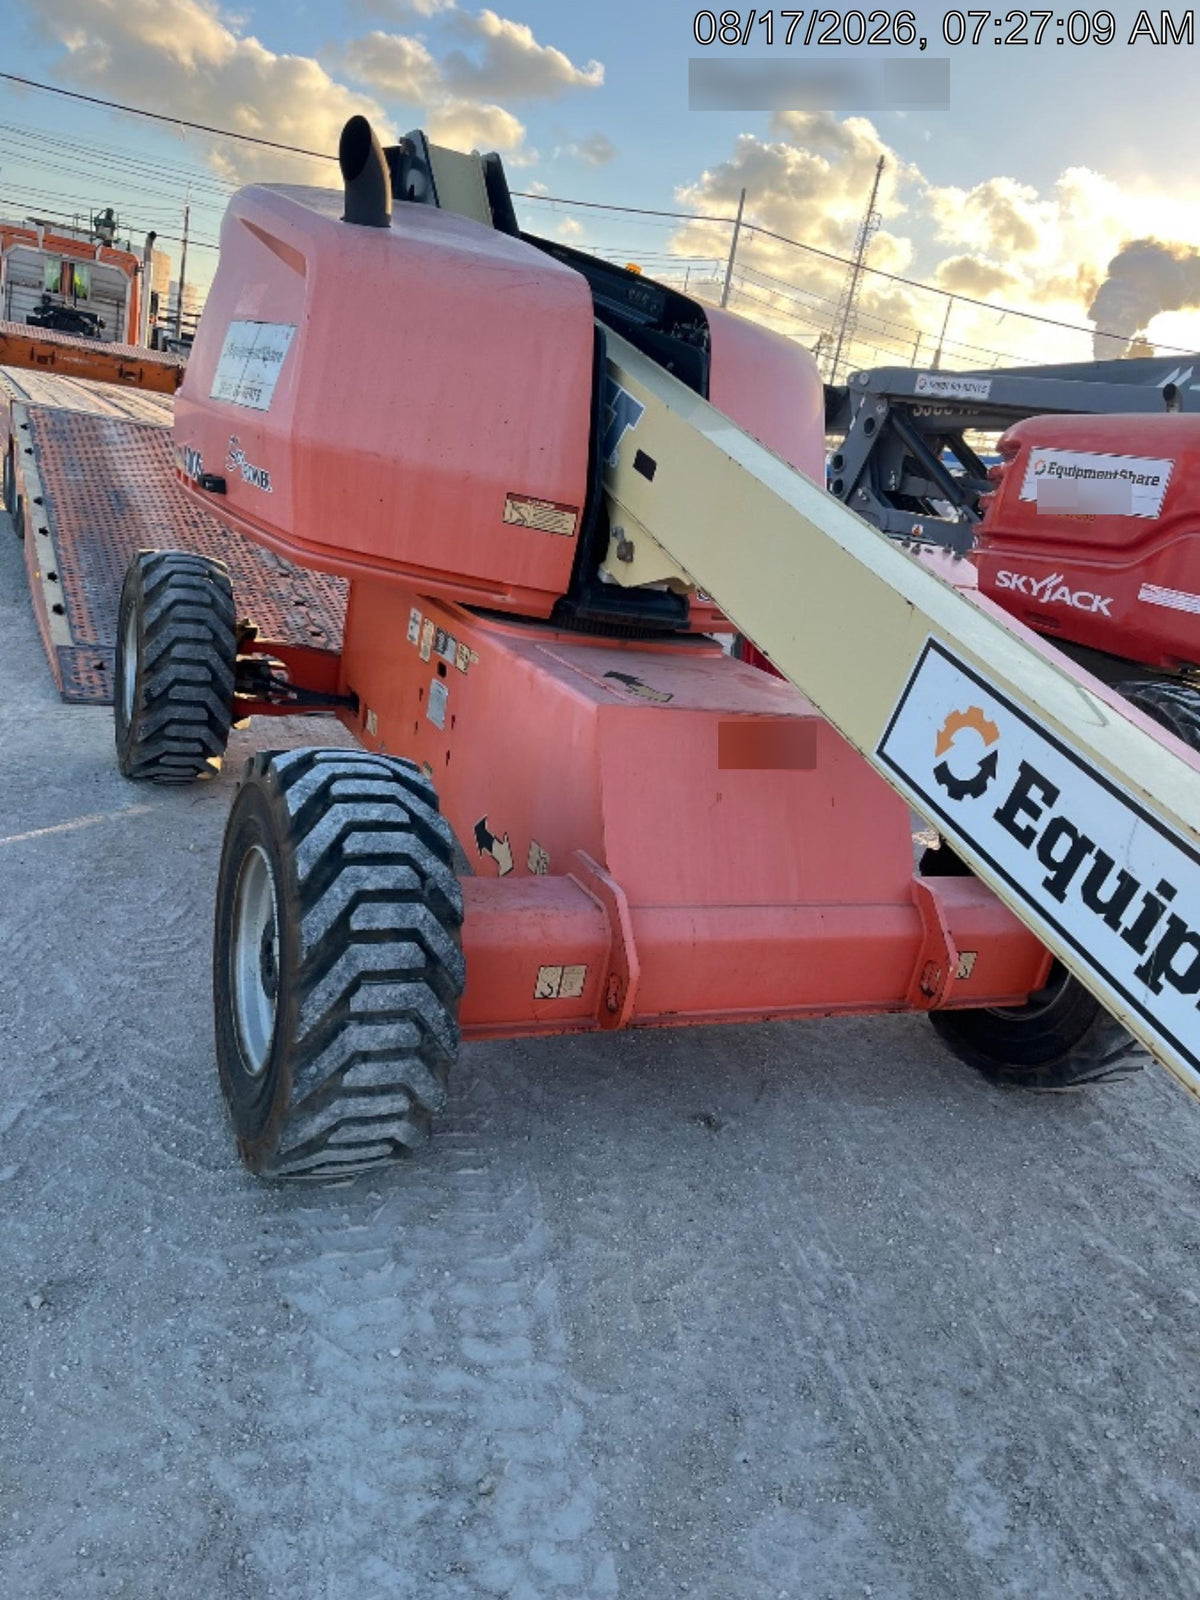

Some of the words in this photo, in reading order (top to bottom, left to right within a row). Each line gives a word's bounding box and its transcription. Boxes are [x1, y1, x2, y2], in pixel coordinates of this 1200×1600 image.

[1047, 462, 1160, 487] EquipmentShare
[995, 570, 1114, 617] SKYJACK
[993, 759, 1200, 1012] Equip
